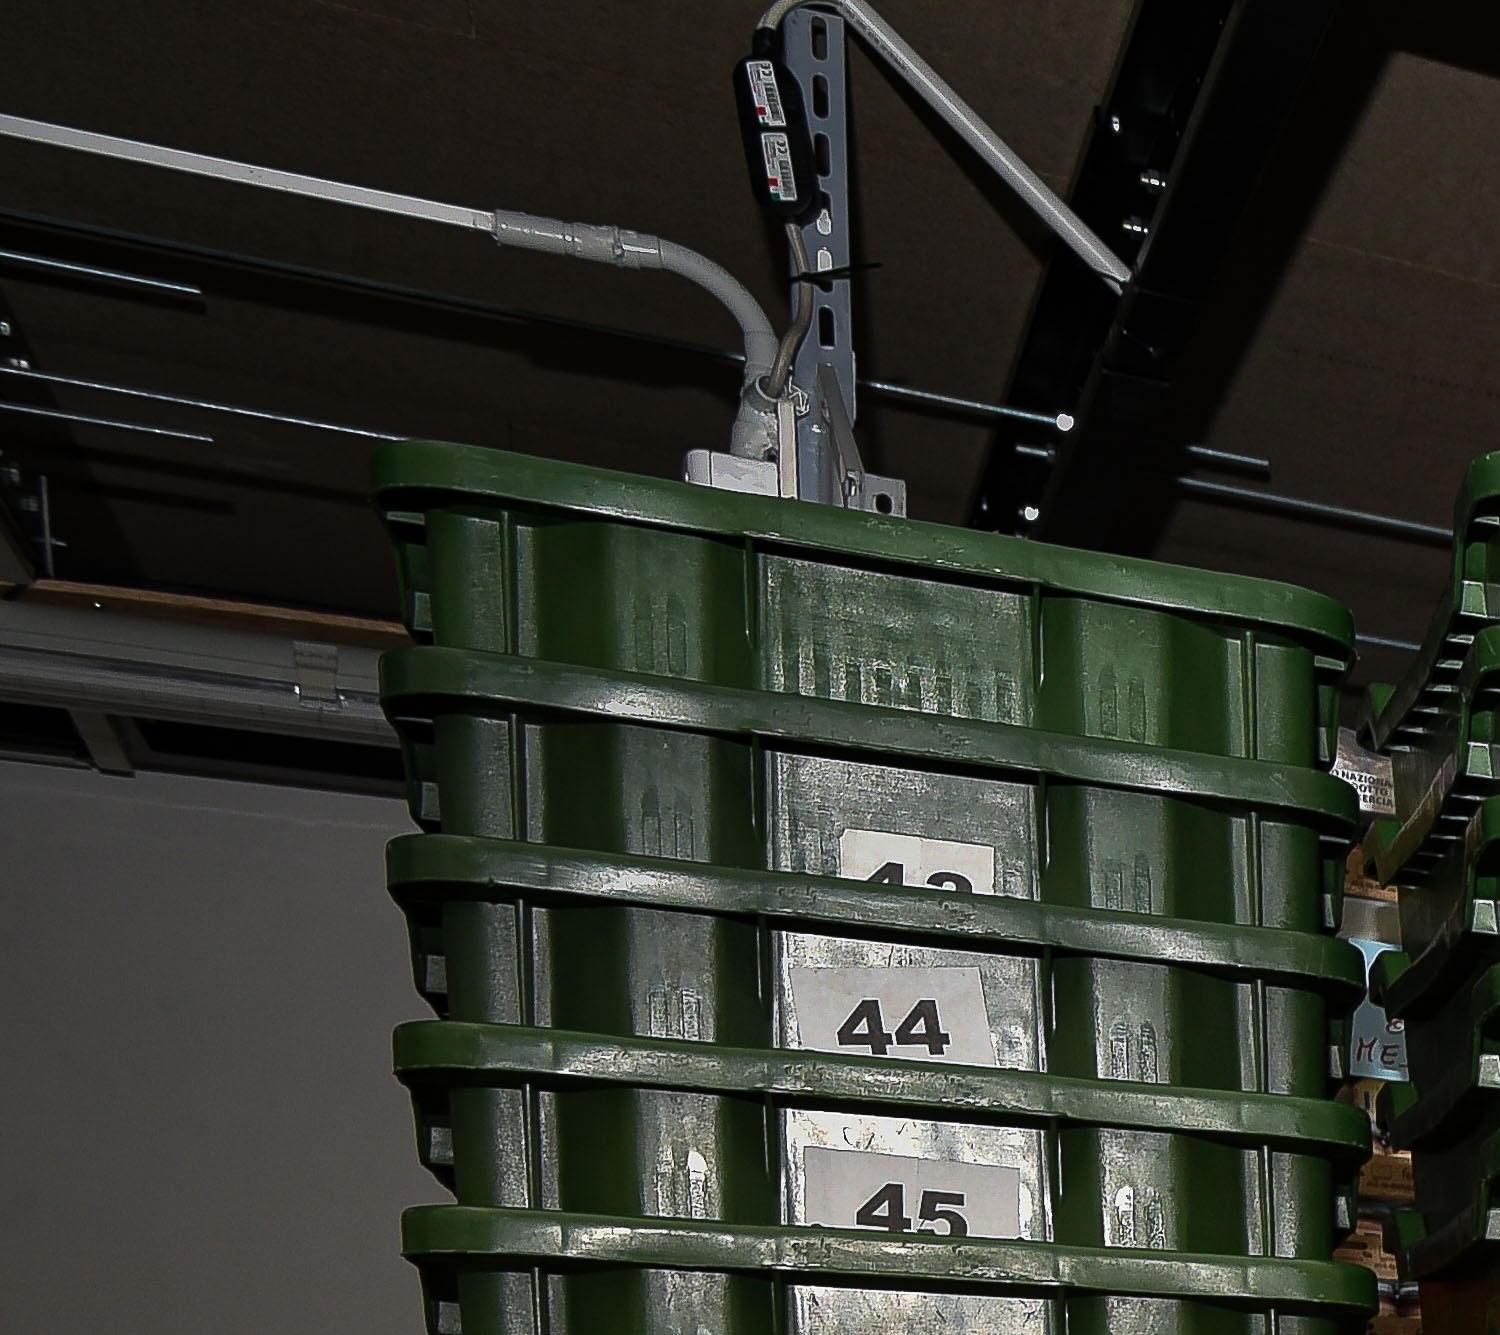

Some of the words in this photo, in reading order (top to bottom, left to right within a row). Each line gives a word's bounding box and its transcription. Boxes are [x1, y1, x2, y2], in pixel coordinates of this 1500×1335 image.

[1341, 771, 1393, 789] NAZIONA
[836, 999, 950, 1056] 44
[855, 1183, 968, 1236] 45
